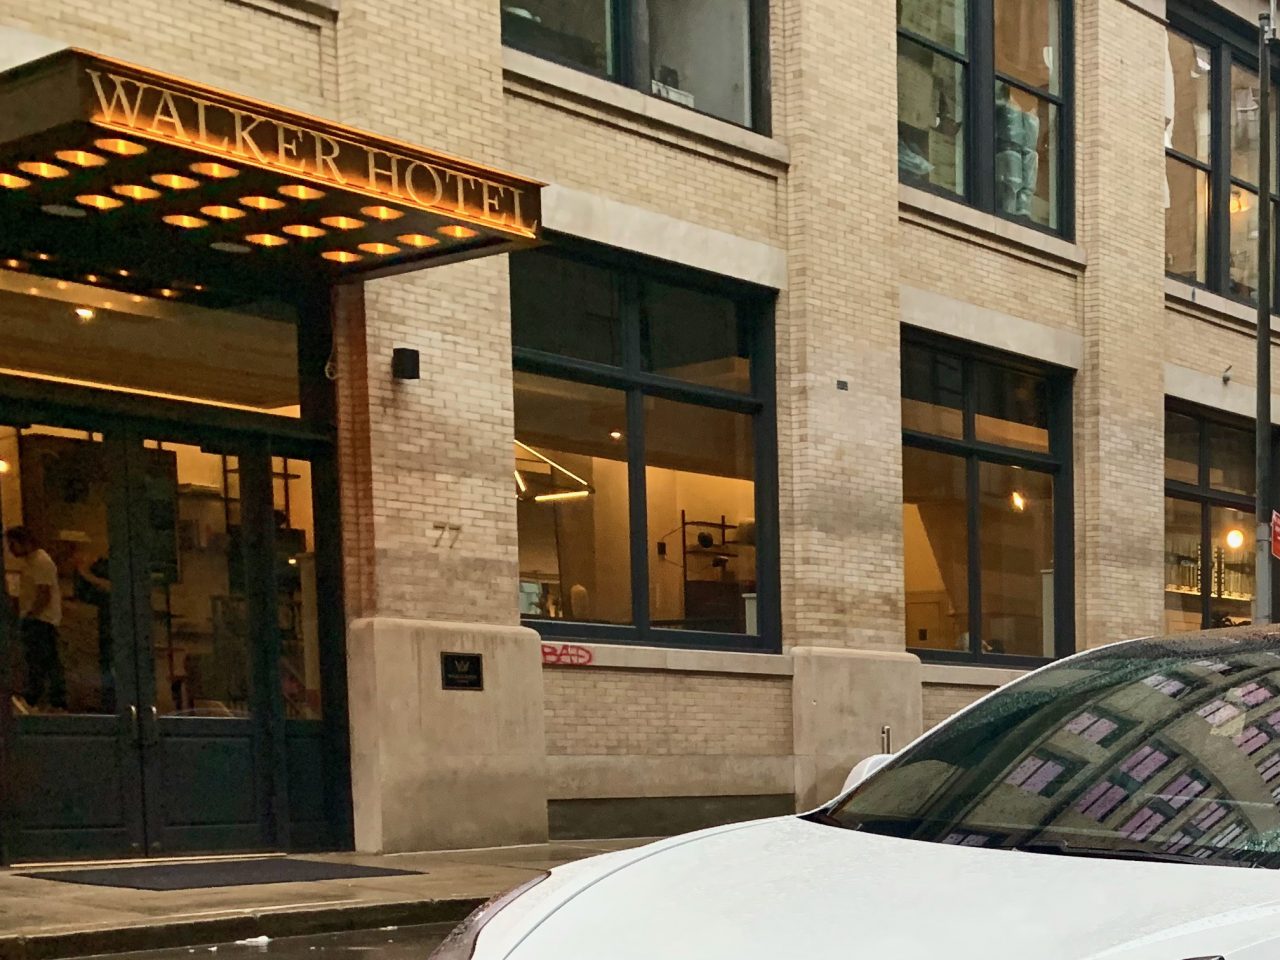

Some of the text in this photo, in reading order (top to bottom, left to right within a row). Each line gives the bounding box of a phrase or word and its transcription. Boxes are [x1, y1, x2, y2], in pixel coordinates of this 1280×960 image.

[84, 68, 538, 237] WALKER HOTEL
[433, 521, 461, 549] 77
